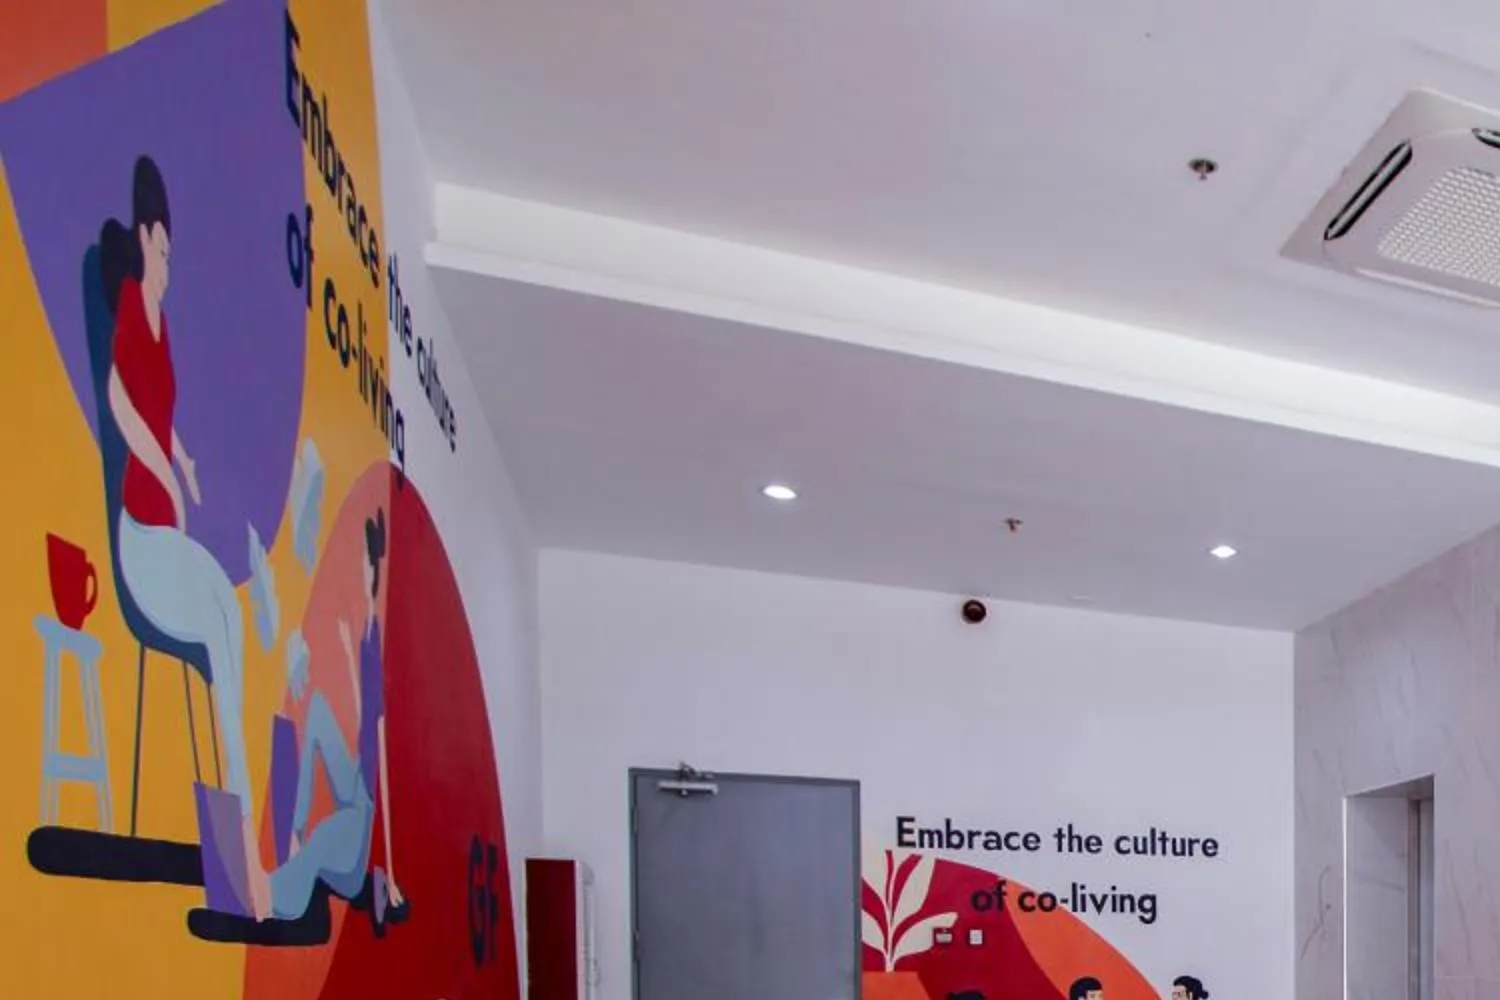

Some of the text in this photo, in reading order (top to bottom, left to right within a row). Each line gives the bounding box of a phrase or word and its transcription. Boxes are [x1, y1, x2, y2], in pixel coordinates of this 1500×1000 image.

[286, 8, 456, 453] Embrace the culture
[287, 203, 405, 490] of co-living
[896, 816, 1219, 857] Embrace the culture
[970, 880, 1157, 924] of co-living
